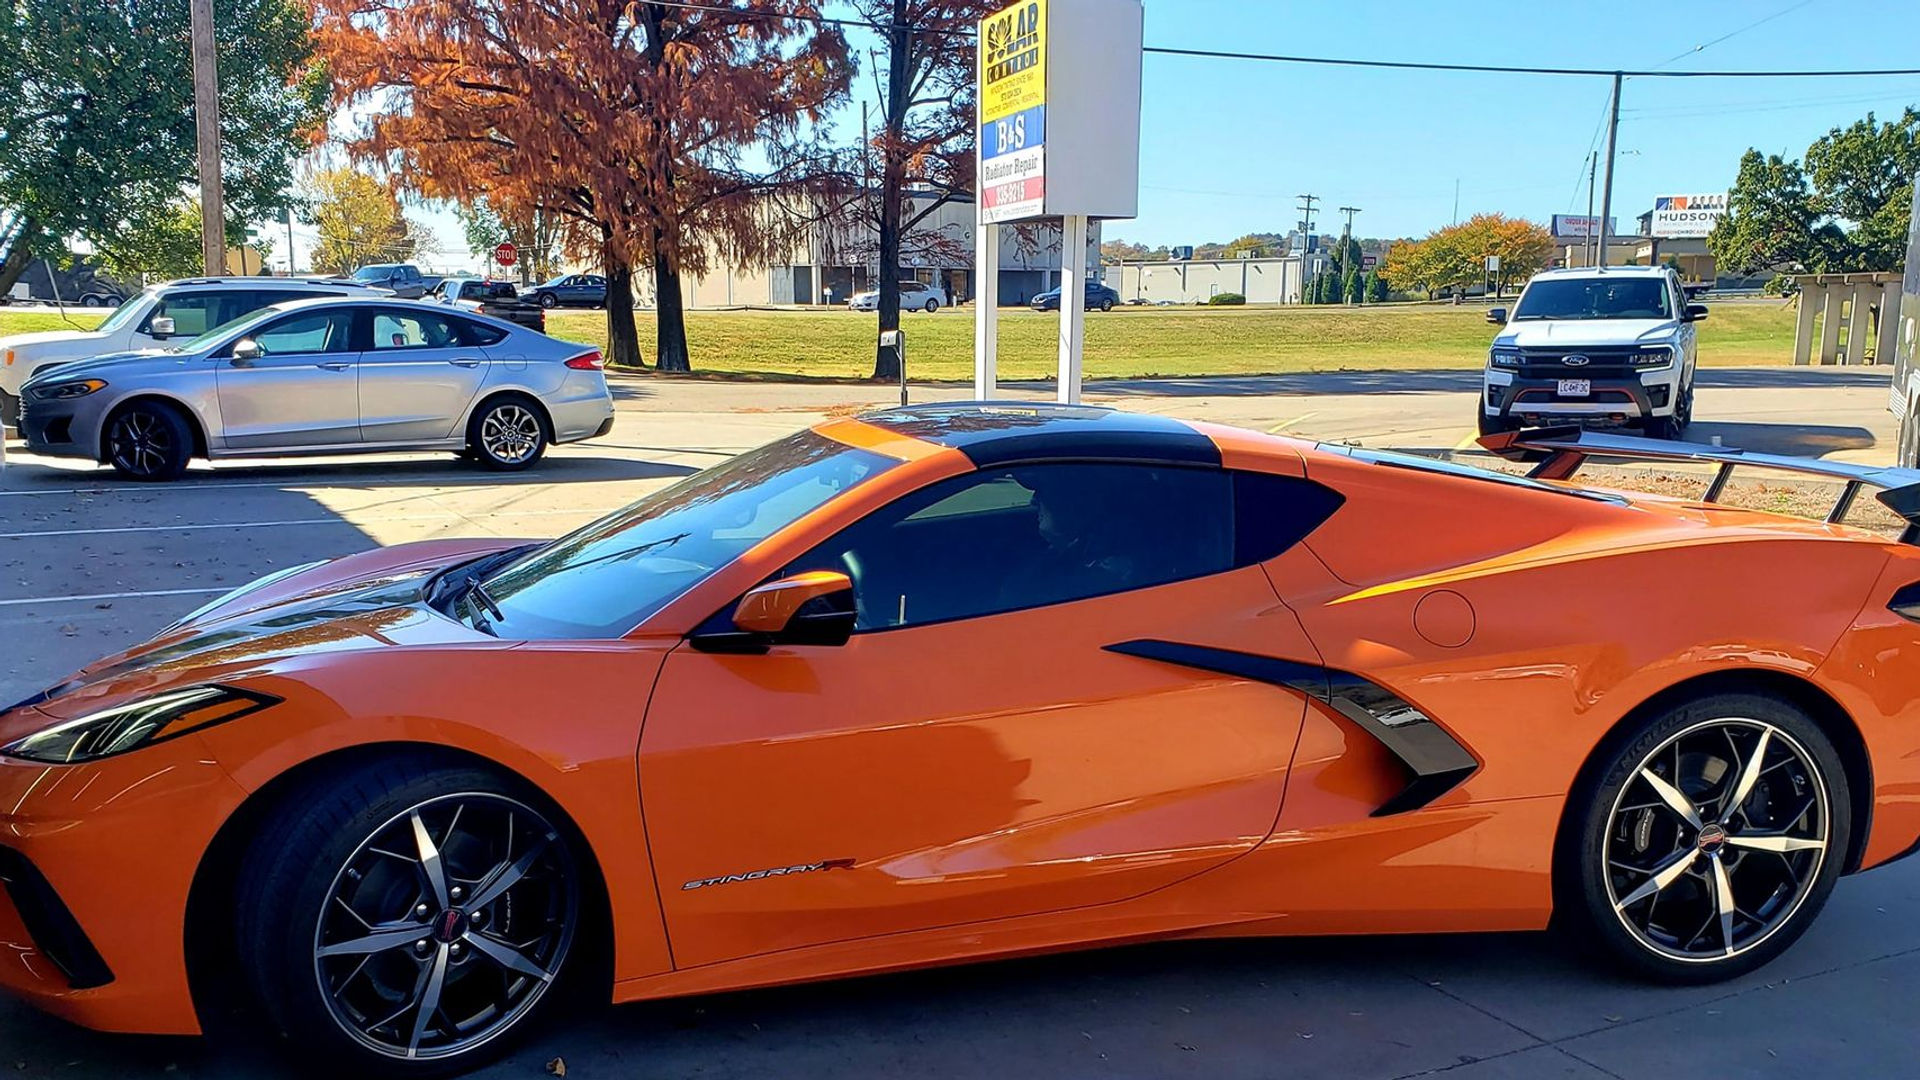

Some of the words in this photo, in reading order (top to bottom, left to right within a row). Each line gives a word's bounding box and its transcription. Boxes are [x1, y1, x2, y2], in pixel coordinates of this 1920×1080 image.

[988, 47, 1038, 84] CONTROL
[998, 114, 1025, 153] B&S
[985, 163, 1013, 181] Radiator
[1014, 154, 1038, 176] Repair
[1659, 213, 1718, 221] HUDSON
[681, 861, 825, 891] STINGRAY
